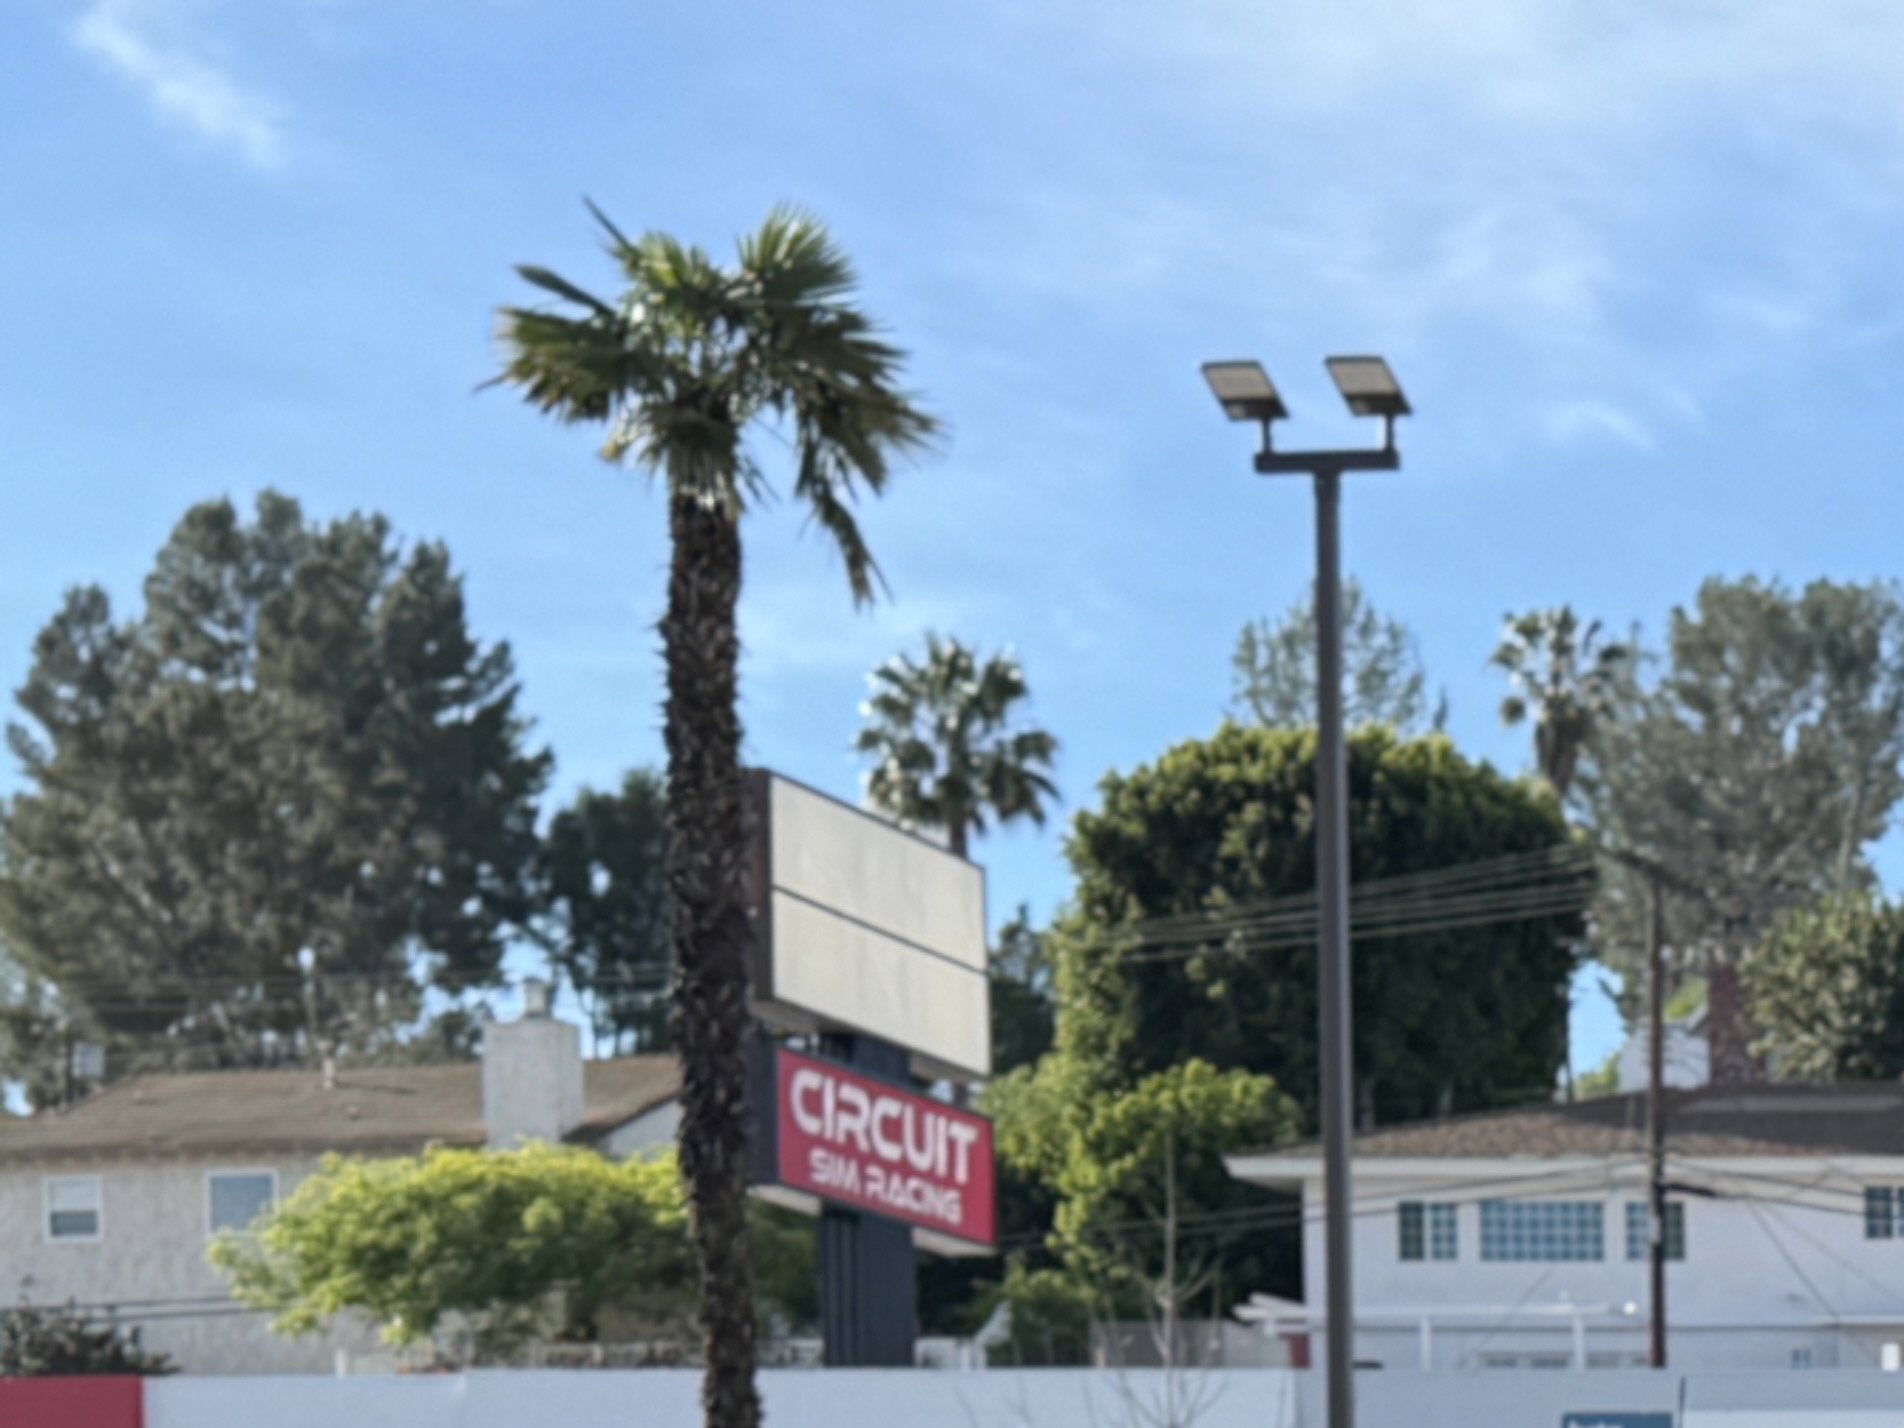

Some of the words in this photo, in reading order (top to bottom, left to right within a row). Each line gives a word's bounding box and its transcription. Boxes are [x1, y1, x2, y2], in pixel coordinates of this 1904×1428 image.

[790, 1068, 979, 1186] CIRCUIT
[810, 1146, 861, 1195] SIM
[864, 1163, 962, 1226] RACING
